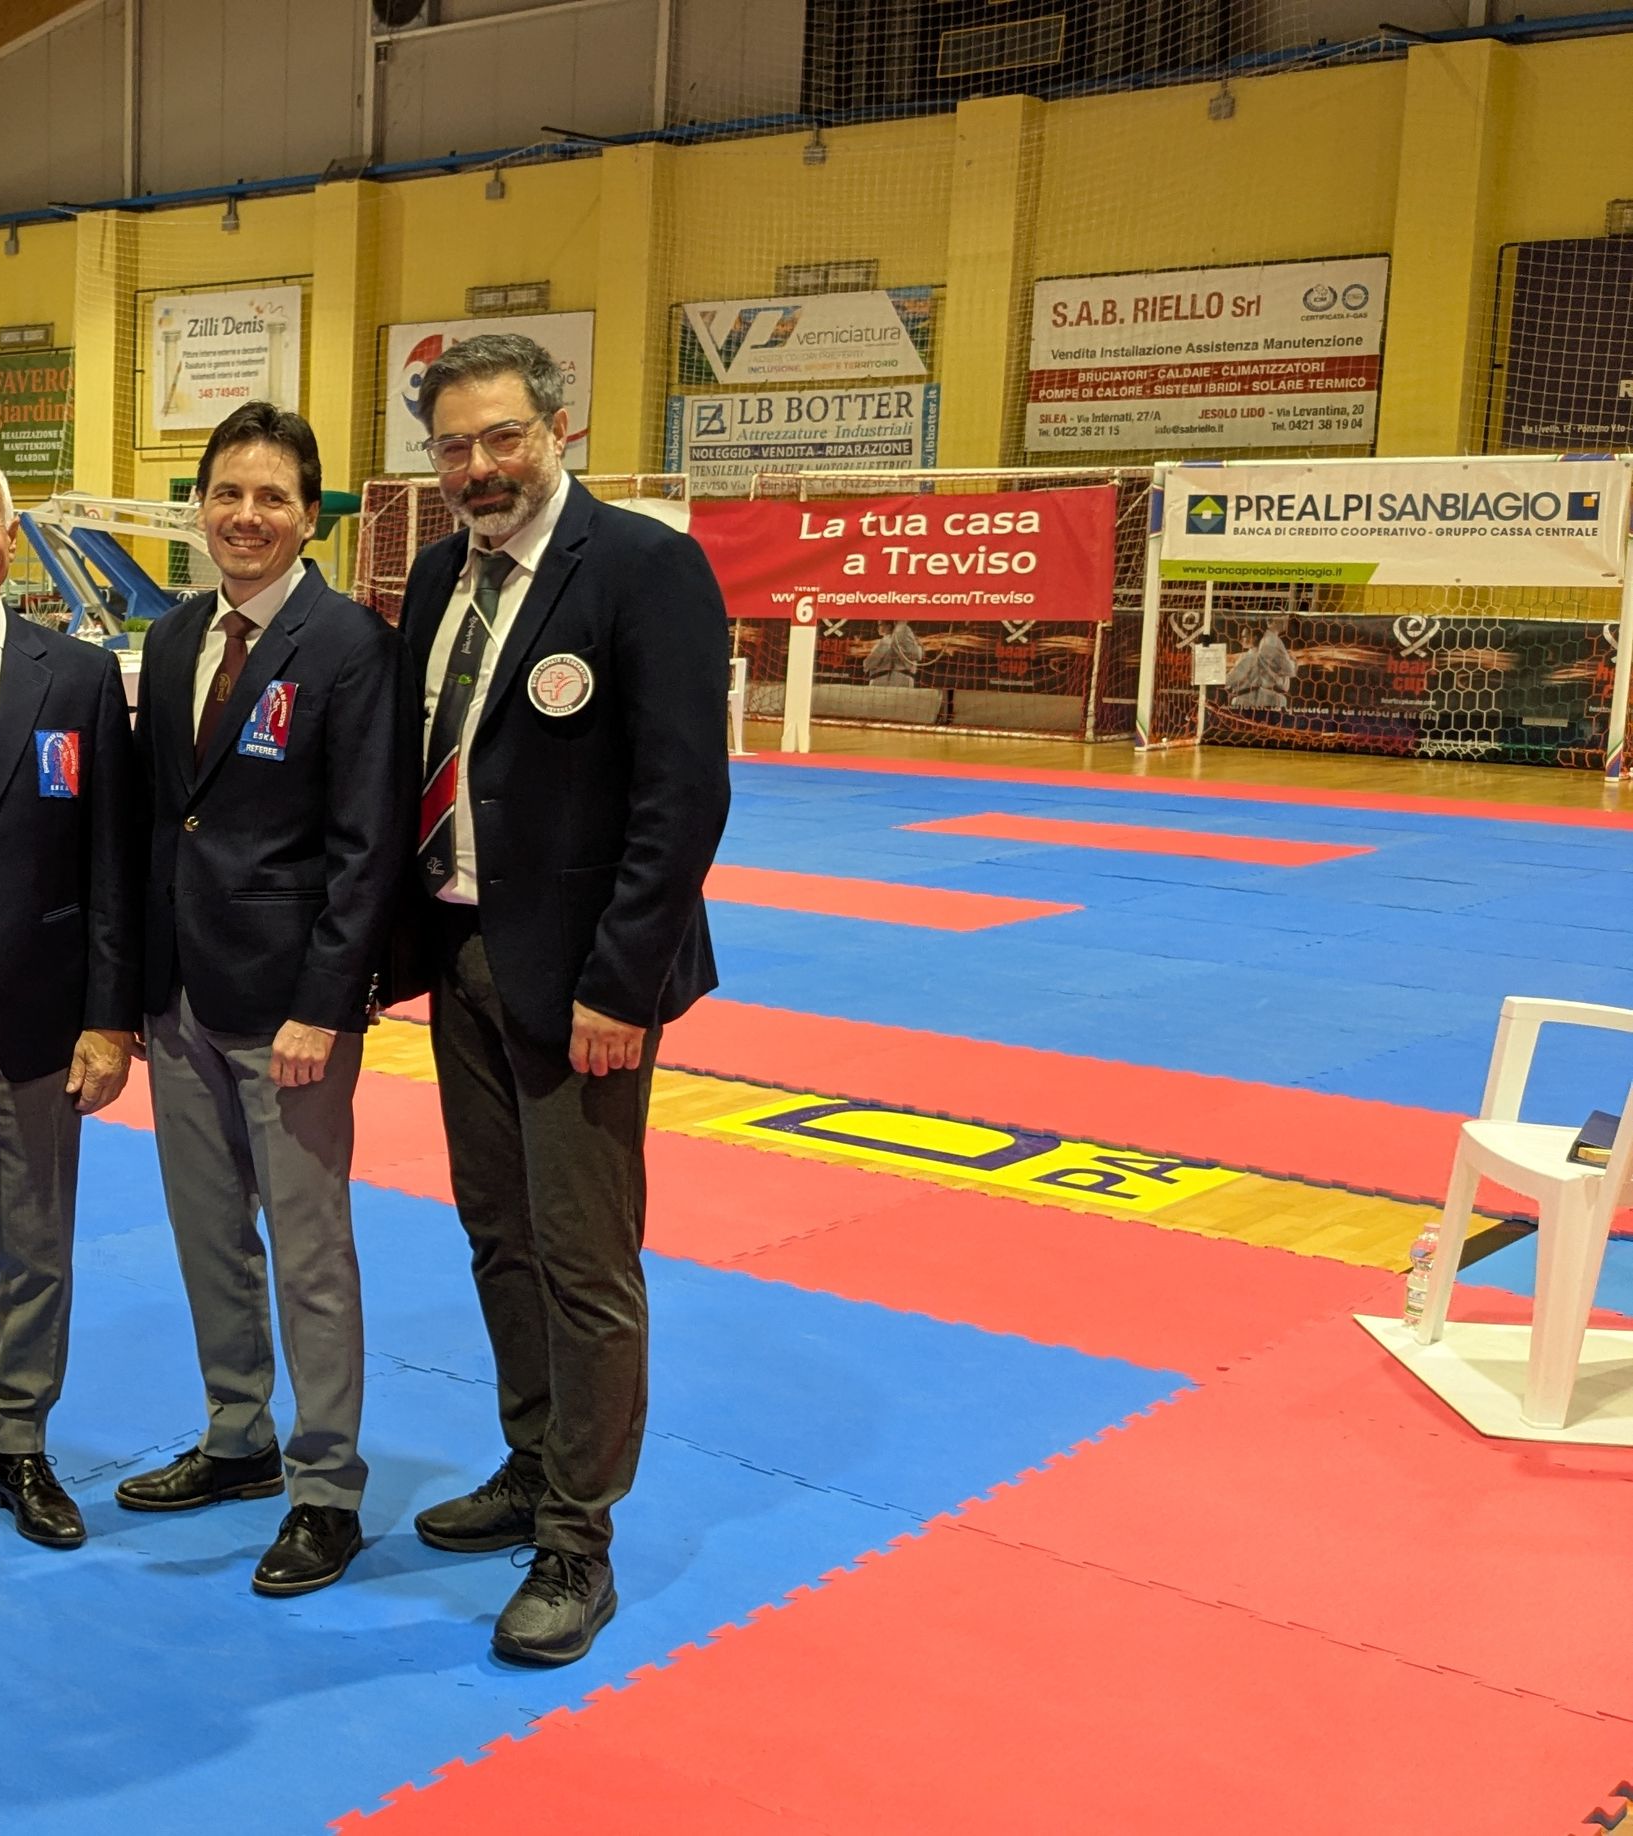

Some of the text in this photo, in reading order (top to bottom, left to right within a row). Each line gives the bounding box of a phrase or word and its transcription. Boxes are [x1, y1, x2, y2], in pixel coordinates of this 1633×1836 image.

[1051, 291, 1262, 328] S.A.B. RIELLO Srl
[187, 315, 264, 338] Zilli Denis
[796, 325, 901, 346] verniciatura
[1051, 335, 1364, 361] Vendita Installazione Assistenza Manutenzione
[843, 359, 899, 370] TERRITORIO
[1078, 369, 1148, 383] BRUCIATORI
[1157, 366, 1211, 379] CALDAIE
[1221, 362, 1325, 377] CLIMATIZZATORI
[1038, 387, 1080, 400] POMPE
[1081, 386, 1094, 399] DI
[1095, 384, 1143, 398] CALORE
[1153, 383, 1203, 396] SISTEMI
[1204, 381, 1242, 394] IBRIDI
[1251, 379, 1305, 392] SOLARE
[1307, 376, 1367, 390] TERMICO
[737, 391, 915, 425] LB BOTTER
[1039, 413, 1067, 425] SILEA
[1136, 409, 1162, 422] 27/A
[1198, 407, 1238, 420] JESOLO
[1240, 406, 1266, 419] LIDO
[1276, 408, 1291, 418] Via
[1292, 404, 1349, 418] Levantina,
[1351, 404, 1365, 415] 20
[736, 421, 913, 442] Attrezzature Industriali
[1052, 426, 1079, 437] 0422
[1287, 420, 1314, 431] 0421
[1335, 418, 1349, 430] 19
[1349, 418, 1363, 429] 04
[692, 447, 752, 460] NOLEGGIO
[761, 445, 815, 458] VENDITA
[825, 442, 910, 457] RIPARAZIONE
[1234, 490, 1561, 523] PREALPI SANBIAGIO
[799, 508, 1041, 541] La tua casa
[1233, 527, 1271, 537] BANCA
[1273, 527, 1286, 537] DI
[1288, 527, 1338, 537] CREDITO
[1340, 527, 1427, 537] COOPERATIVO
[1435, 527, 1487, 537] GRUPPO
[1490, 527, 1532, 537] CASSA
[1535, 527, 1599, 537] CENTRALE
[842, 544, 1038, 576] a Treviso
[1182, 564, 1343, 579] www.bancaprealpisanbiagio.it
[795, 595, 814, 623] 6
[252, 731, 276, 743] ESKA
[245, 743, 279, 757] REFEREE
